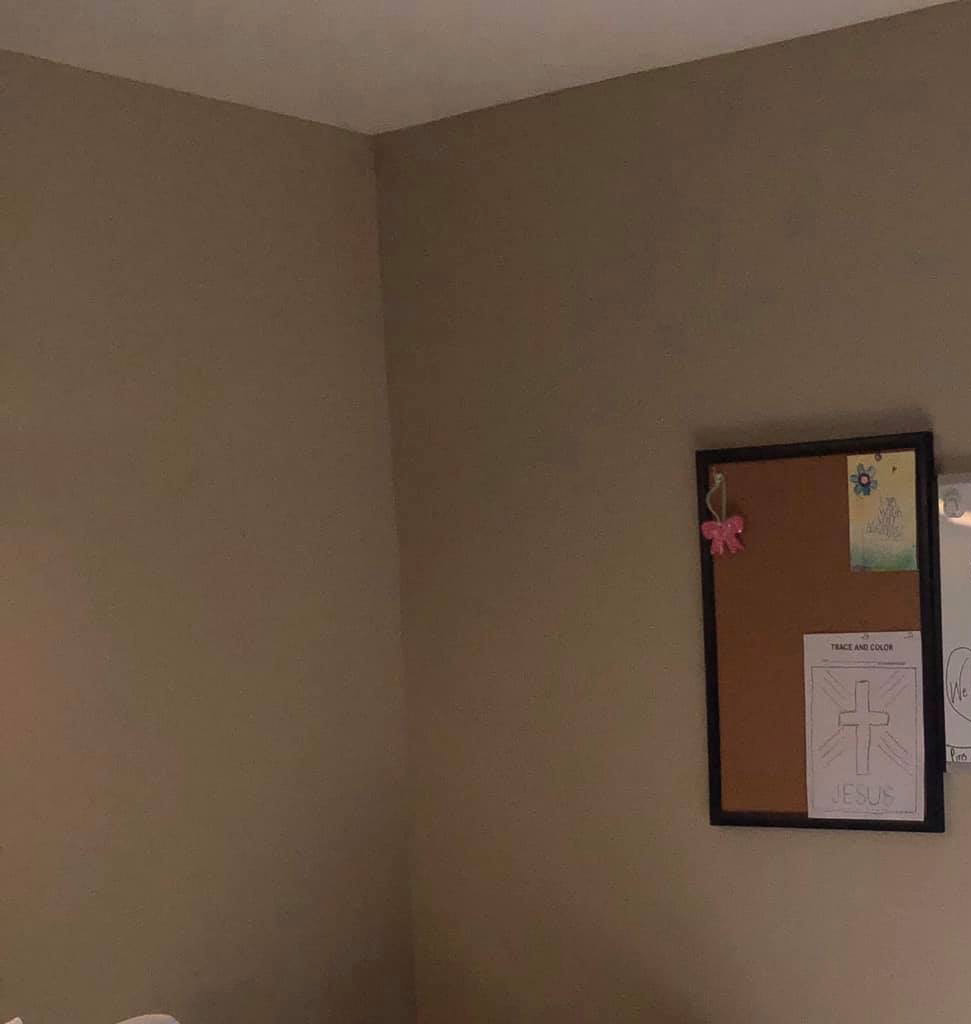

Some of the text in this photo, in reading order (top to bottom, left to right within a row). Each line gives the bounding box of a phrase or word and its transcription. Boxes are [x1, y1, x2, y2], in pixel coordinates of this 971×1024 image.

[831, 643, 894, 651] TRACE AND COLOR
[950, 681, 968, 704] We
[832, 783, 895, 807] JESUS
